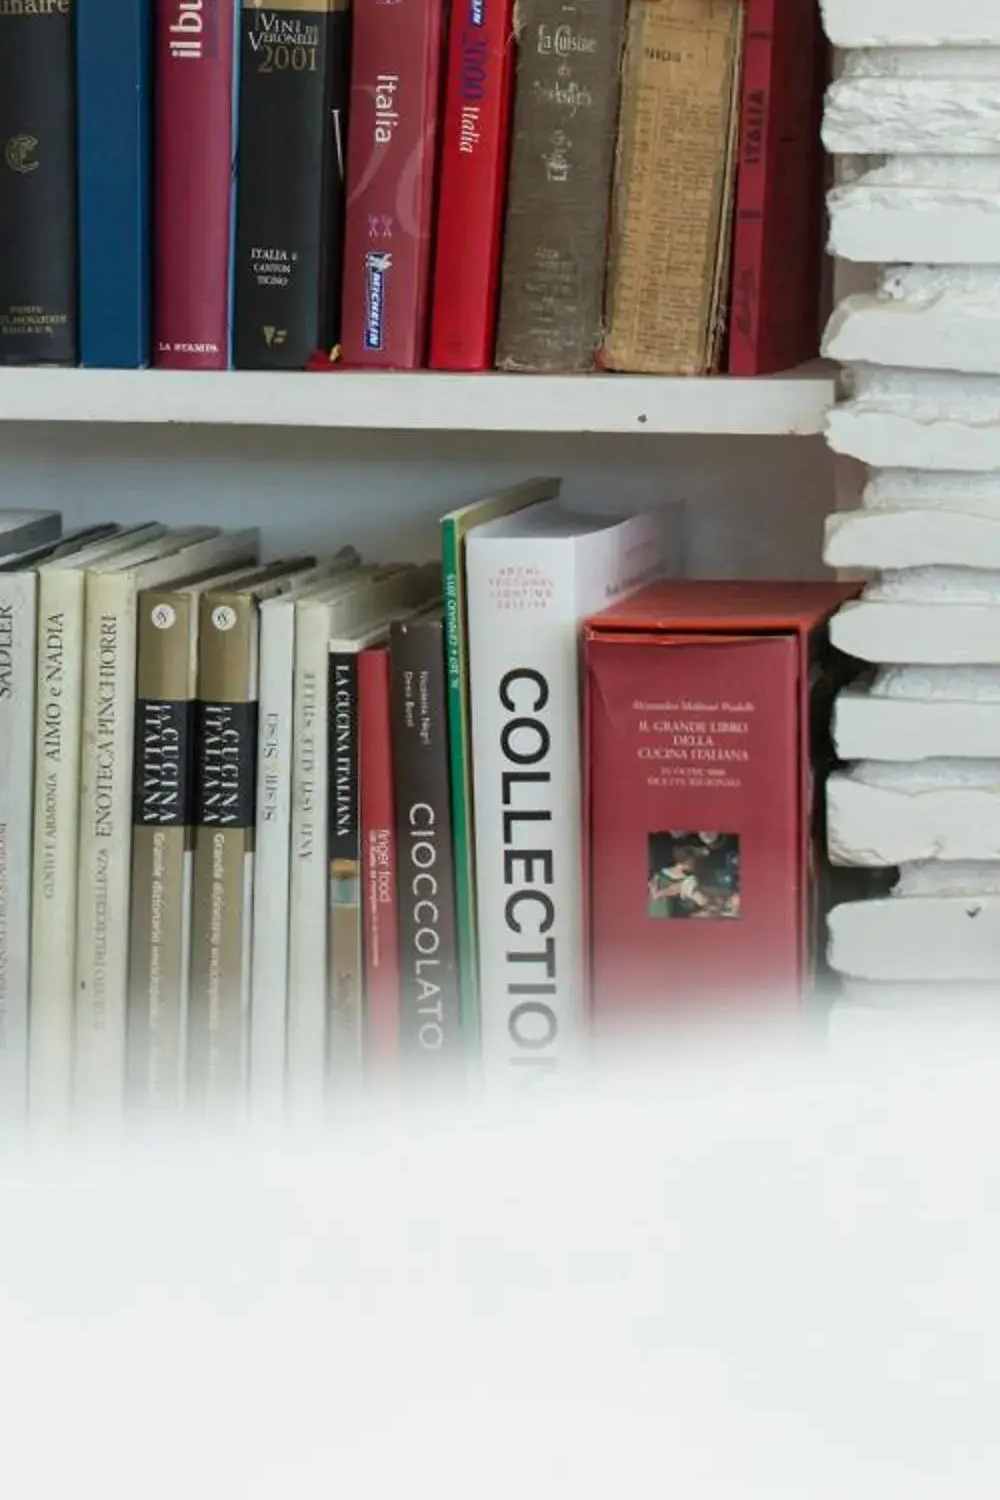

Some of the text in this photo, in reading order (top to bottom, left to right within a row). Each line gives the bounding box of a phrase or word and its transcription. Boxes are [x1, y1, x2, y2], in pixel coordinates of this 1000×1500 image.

[169, 41, 202, 59] il
[257, 46, 318, 74] 2001
[374, 74, 399, 145] Italia
[459, 105, 481, 153] Italia
[743, 89, 767, 164] ITALIA
[250, 247, 288, 262] ITALIA
[370, 271, 384, 347] MICHELIN
[44, 611, 65, 762] AIMO e NADIA
[95, 614, 118, 838] ENOTECA PINCHIORRI
[143, 704, 161, 822] ITALIANA
[334, 665, 351, 836] LA CUCINA ITALIANA
[637, 748, 749, 761] CUCINA ITALIANA
[638, 720, 749, 733] IL GRANDE LIBRO
[672, 734, 714, 746] DELLA
[160, 727, 179, 822] CUCINA
[203, 705, 222, 823] ITALIANA
[220, 728, 240, 824] CUCINA
[377, 829, 392, 903] finger food
[409, 802, 444, 1051] CIOCCOLATO
